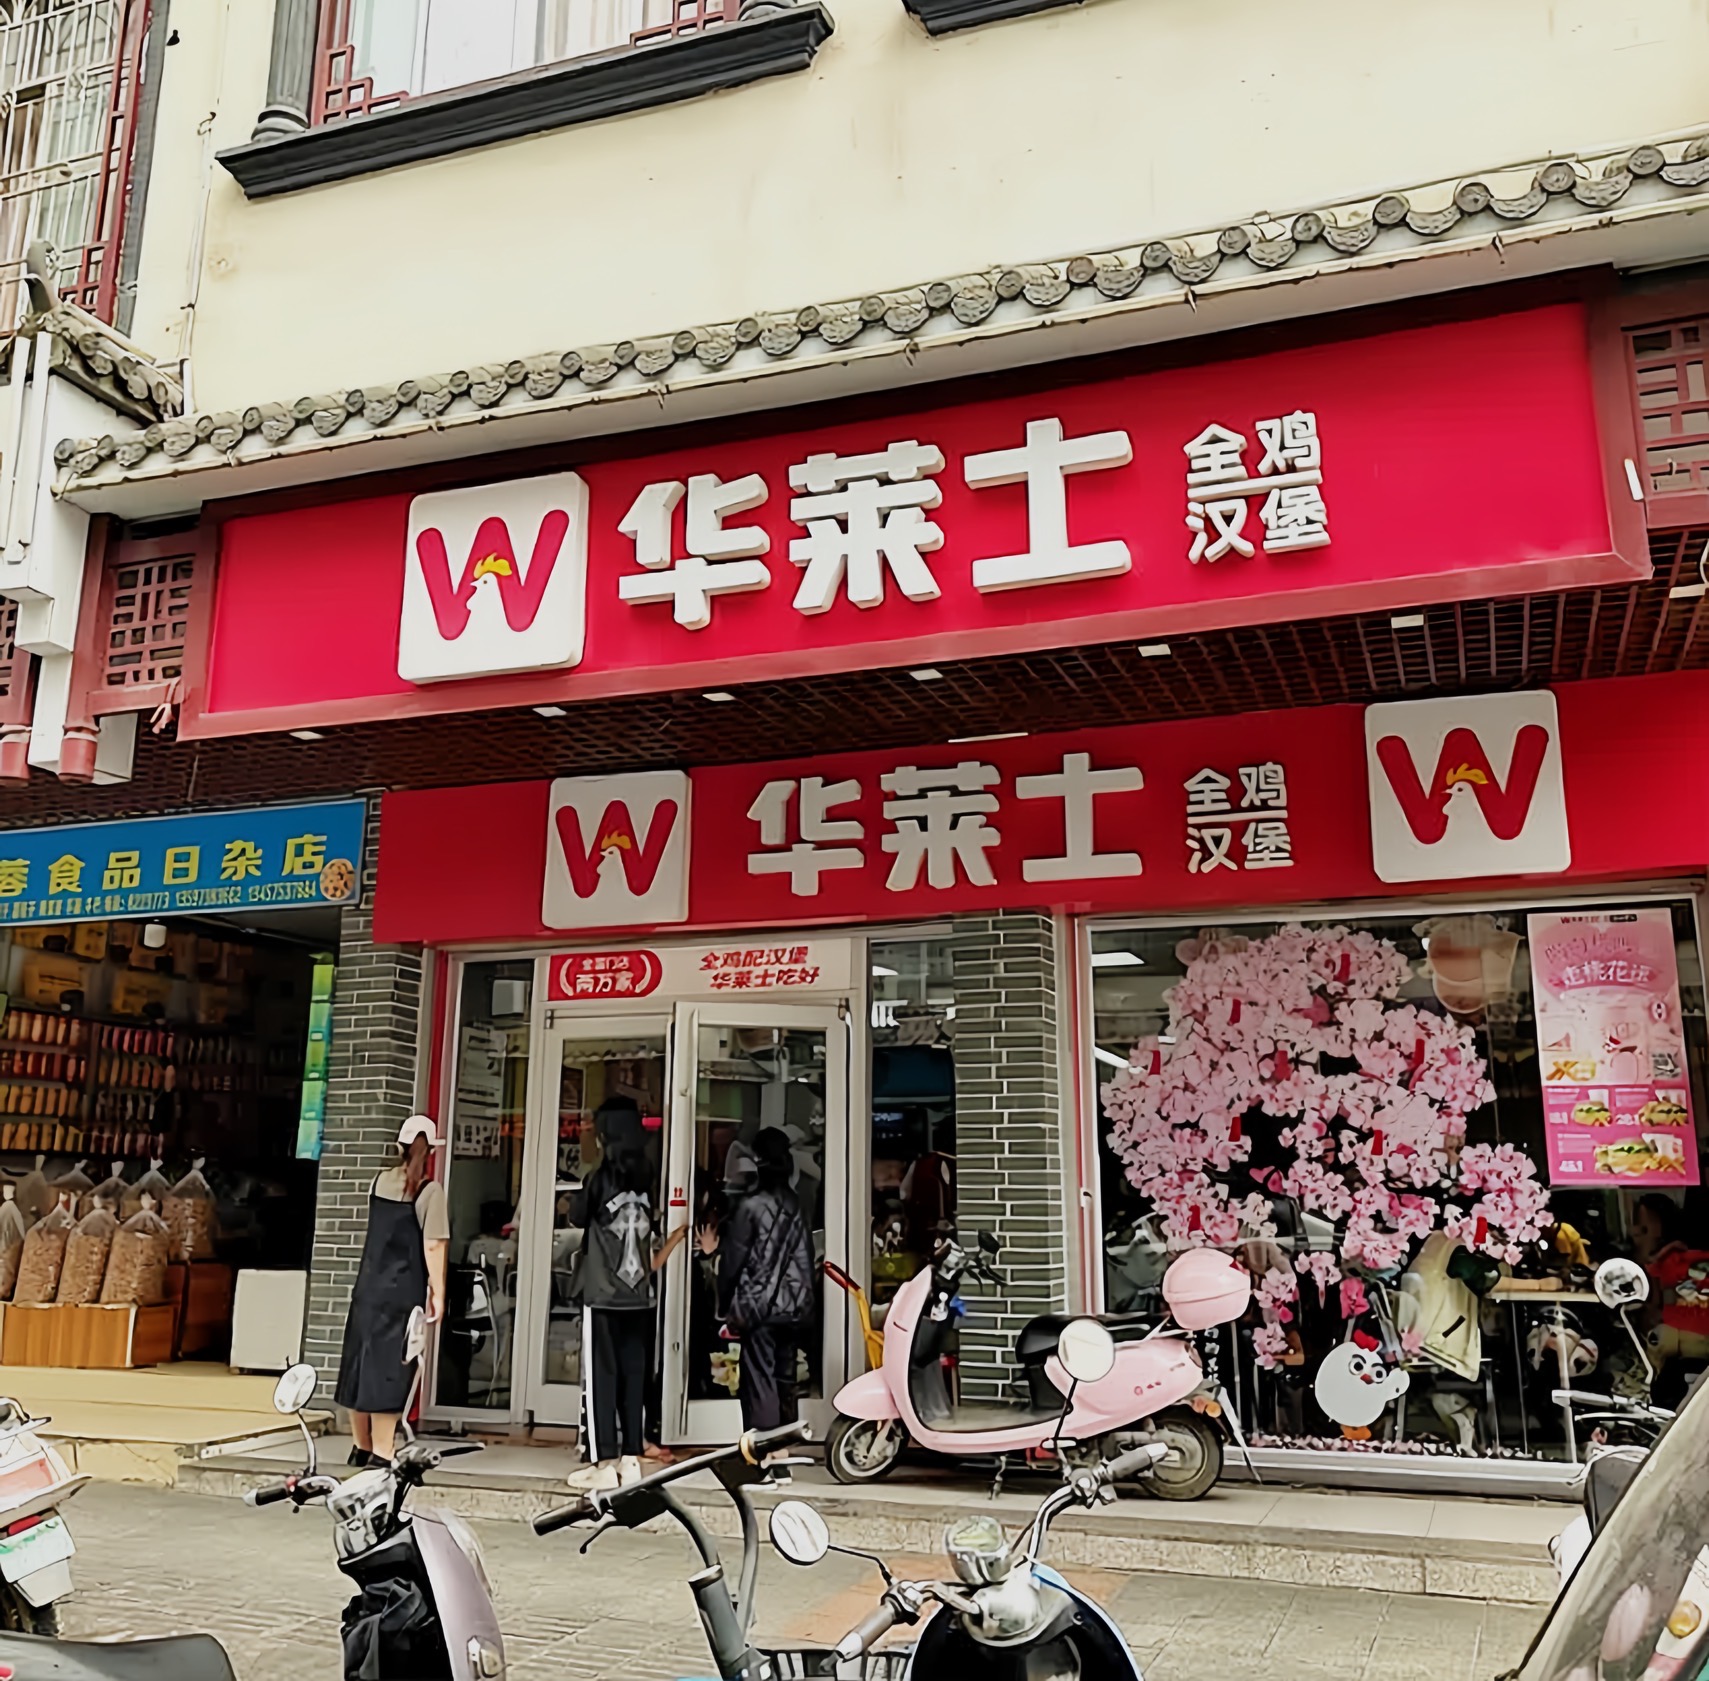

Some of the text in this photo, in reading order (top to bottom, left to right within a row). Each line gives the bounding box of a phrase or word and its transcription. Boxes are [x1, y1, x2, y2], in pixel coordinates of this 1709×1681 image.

[1183, 410, 1322, 487] 全鸡
[617, 416, 1133, 630] 华莱士
[1185, 485, 1331, 565] 汉堡
[416, 509, 570, 641] W
[746, 752, 1144, 897] 华莱士
[1183, 761, 1288, 814] 全鸡
[1376, 724, 1549, 845] W
[555, 799, 678, 899] W
[1185, 821, 1295, 874] 汉堡
[699, 946, 809, 971] 全鸡配汉堡
[709, 966, 820, 990] 华莱士吃好
